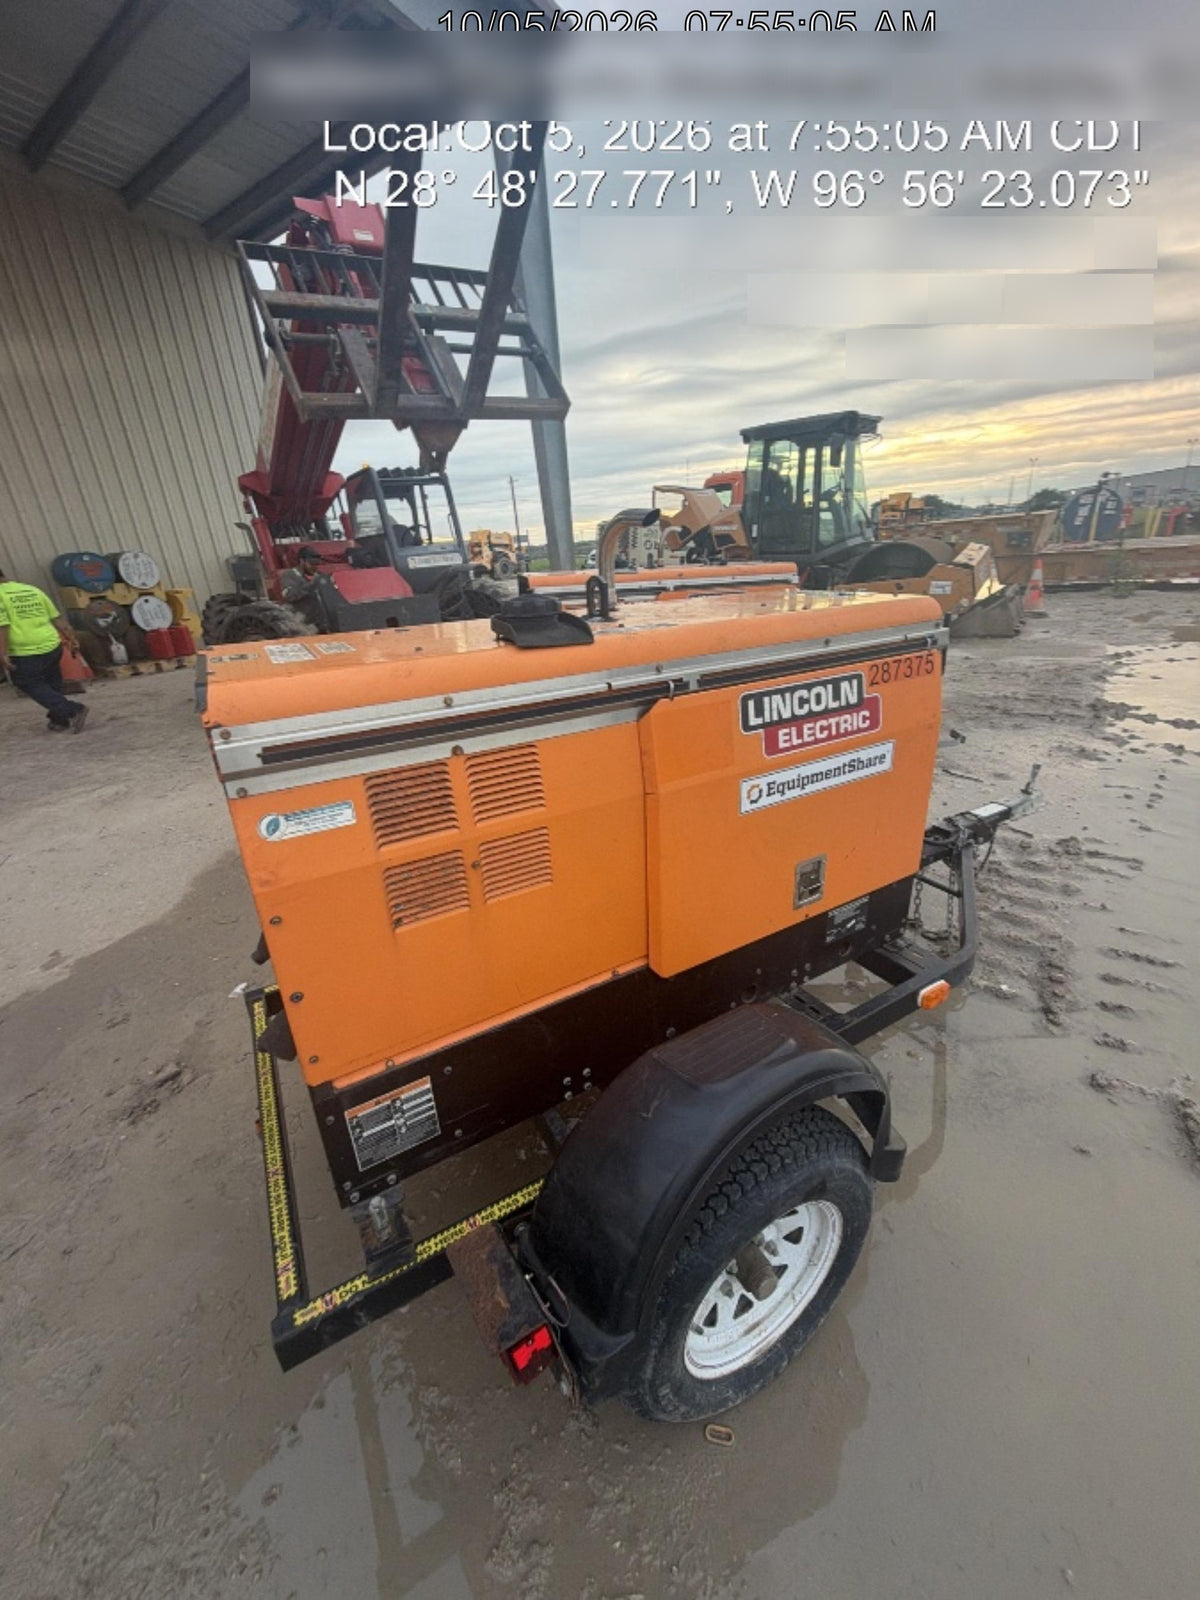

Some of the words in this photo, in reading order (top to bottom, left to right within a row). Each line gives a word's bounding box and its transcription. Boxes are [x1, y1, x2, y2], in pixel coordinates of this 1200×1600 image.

[868, 653, 936, 687] 287375
[747, 679, 859, 727] LINCOLN
[777, 709, 871, 749] ELECTRIC
[765, 751, 887, 798] EquipmentShare
